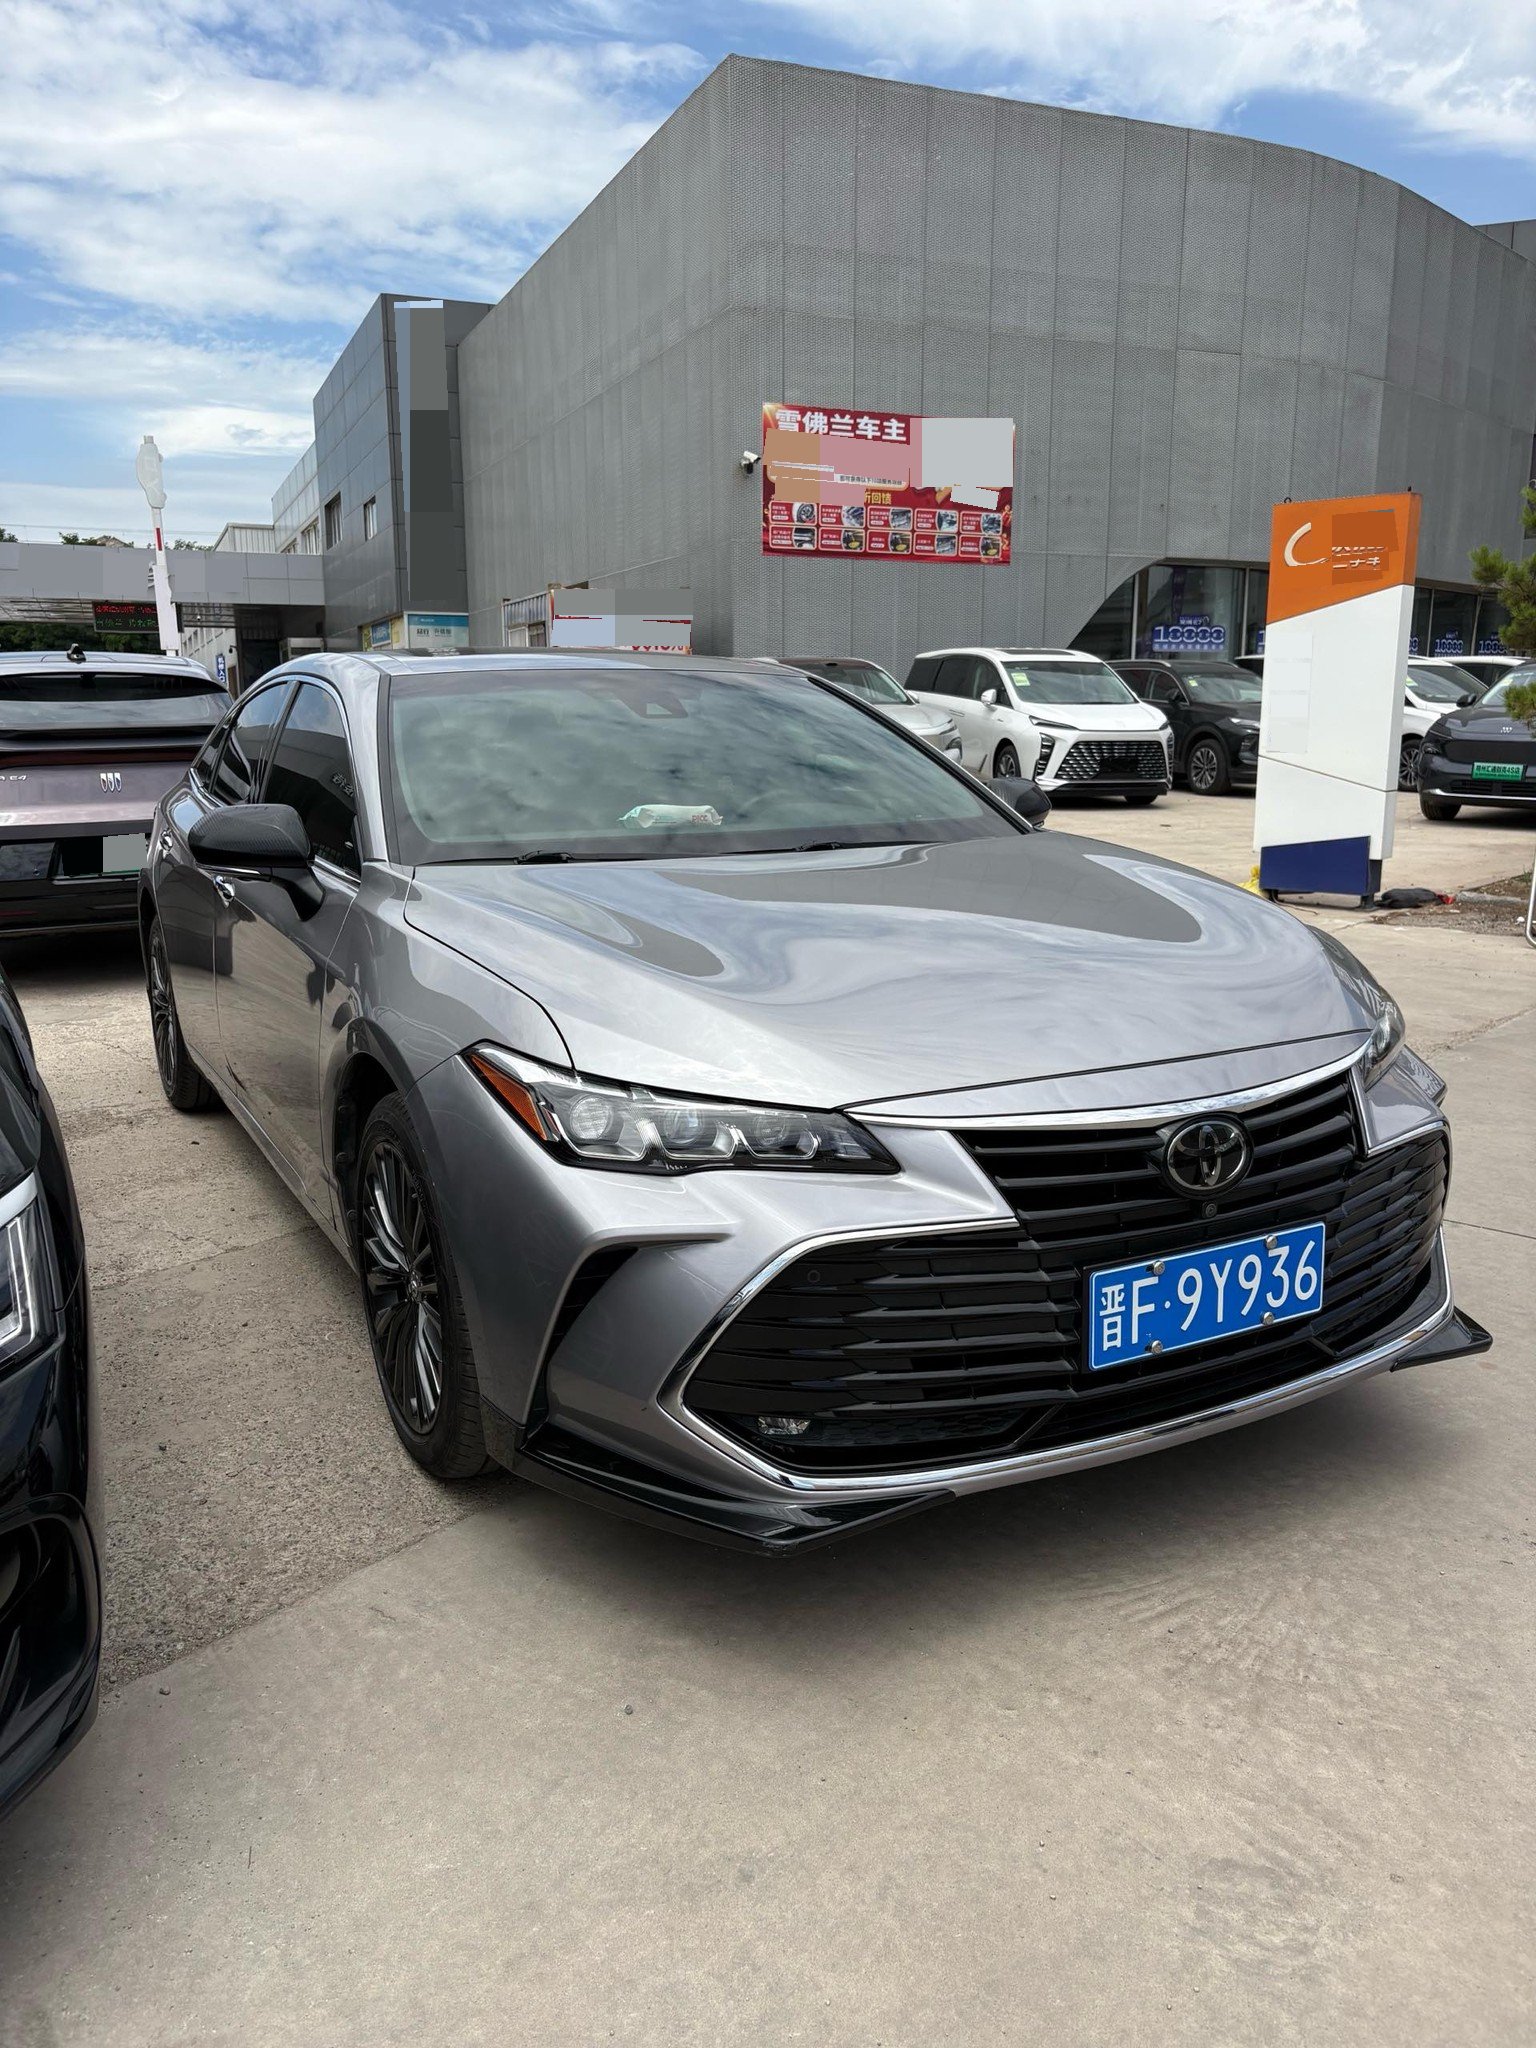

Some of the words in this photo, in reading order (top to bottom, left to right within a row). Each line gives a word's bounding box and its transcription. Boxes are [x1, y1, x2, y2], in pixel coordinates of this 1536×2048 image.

[776, 409, 907, 442] 雪佛兰车主
[1153, 625, 1225, 644] 10000
